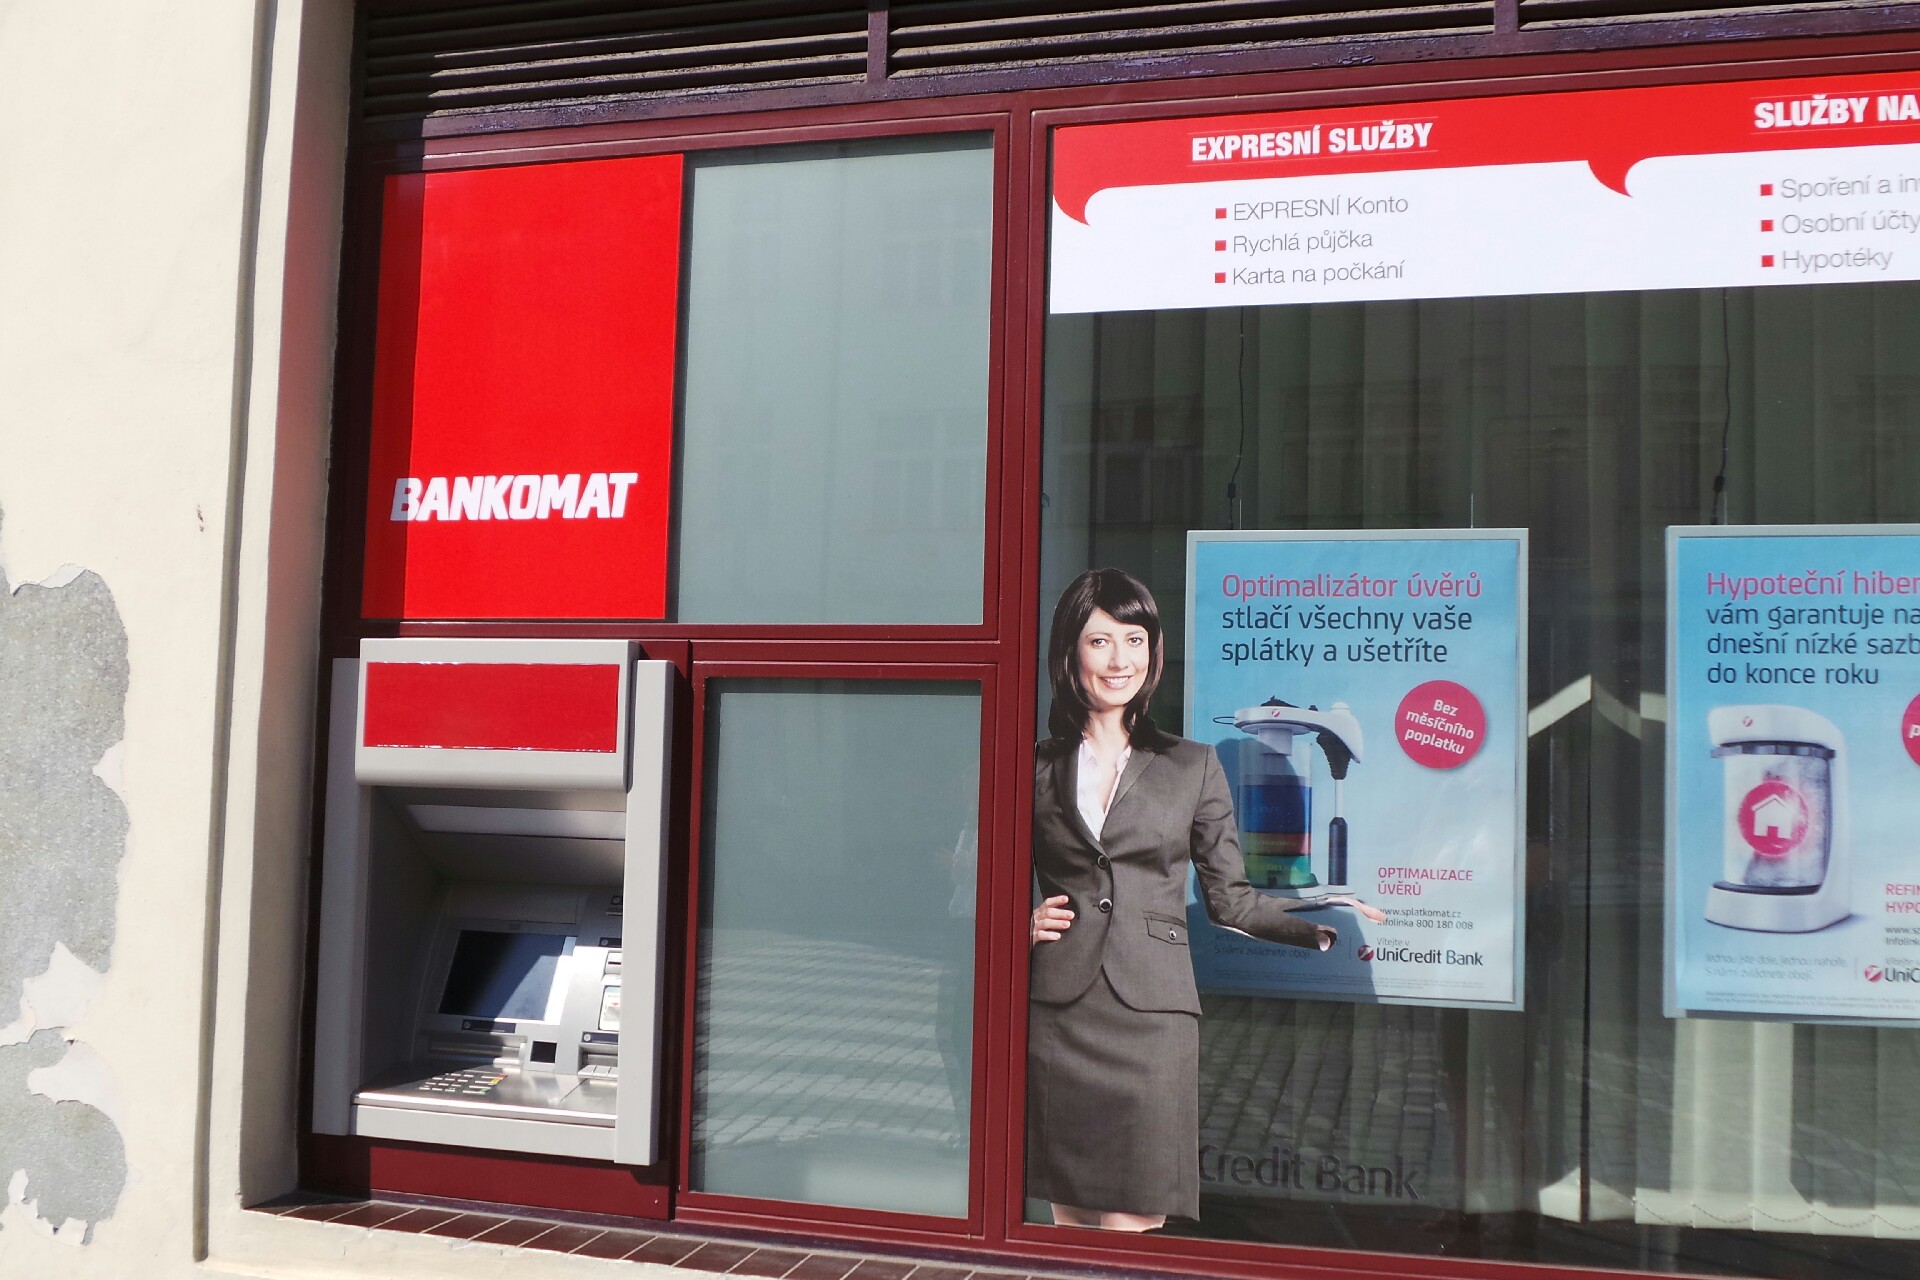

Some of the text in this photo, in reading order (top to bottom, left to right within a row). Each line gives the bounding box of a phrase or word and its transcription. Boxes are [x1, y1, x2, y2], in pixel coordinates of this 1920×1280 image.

[1754, 94, 1920, 129] SLUŽBY NA
[1192, 119, 1434, 161] EXPRESNÍ SLUŽBY
[1781, 174, 1920, 202] Spoření a in
[1234, 195, 1409, 221] EXPRESNÍ Konto
[1782, 210, 1920, 234] Osobní účty
[1233, 230, 1373, 256] Rychlá půjčka
[1233, 260, 1406, 285] Karta na počkání
[1782, 248, 1893, 274] Hypotéky
[390, 472, 638, 521] BANKOMAT
[1222, 572, 1482, 602] Optimalizátor úvěrů
[1707, 570, 1847, 600] Hypoteční
[1222, 604, 1473, 635] stlačí všechny vaše
[1706, 602, 1920, 630] vám garantuje na
[1222, 637, 1448, 667] splátky a ušetříte
[1707, 631, 1920, 655] dnešní nízké sazb
[1707, 662, 1879, 685] do konce roku
[1433, 699, 1459, 718] Bez
[1406, 709, 1475, 740] měsíčního
[1404, 728, 1465, 755] poplatku
[1378, 867, 1473, 882] OPTIMALIZACE
[1378, 880, 1422, 896] ÚVĚRŮ
[1416, 919, 1434, 928] 800
[1436, 920, 1454, 929] 180
[1455, 921, 1474, 930] 008
[1376, 947, 1484, 966] UniCredit Bank
[1316, 1153, 1422, 1200] Bank
